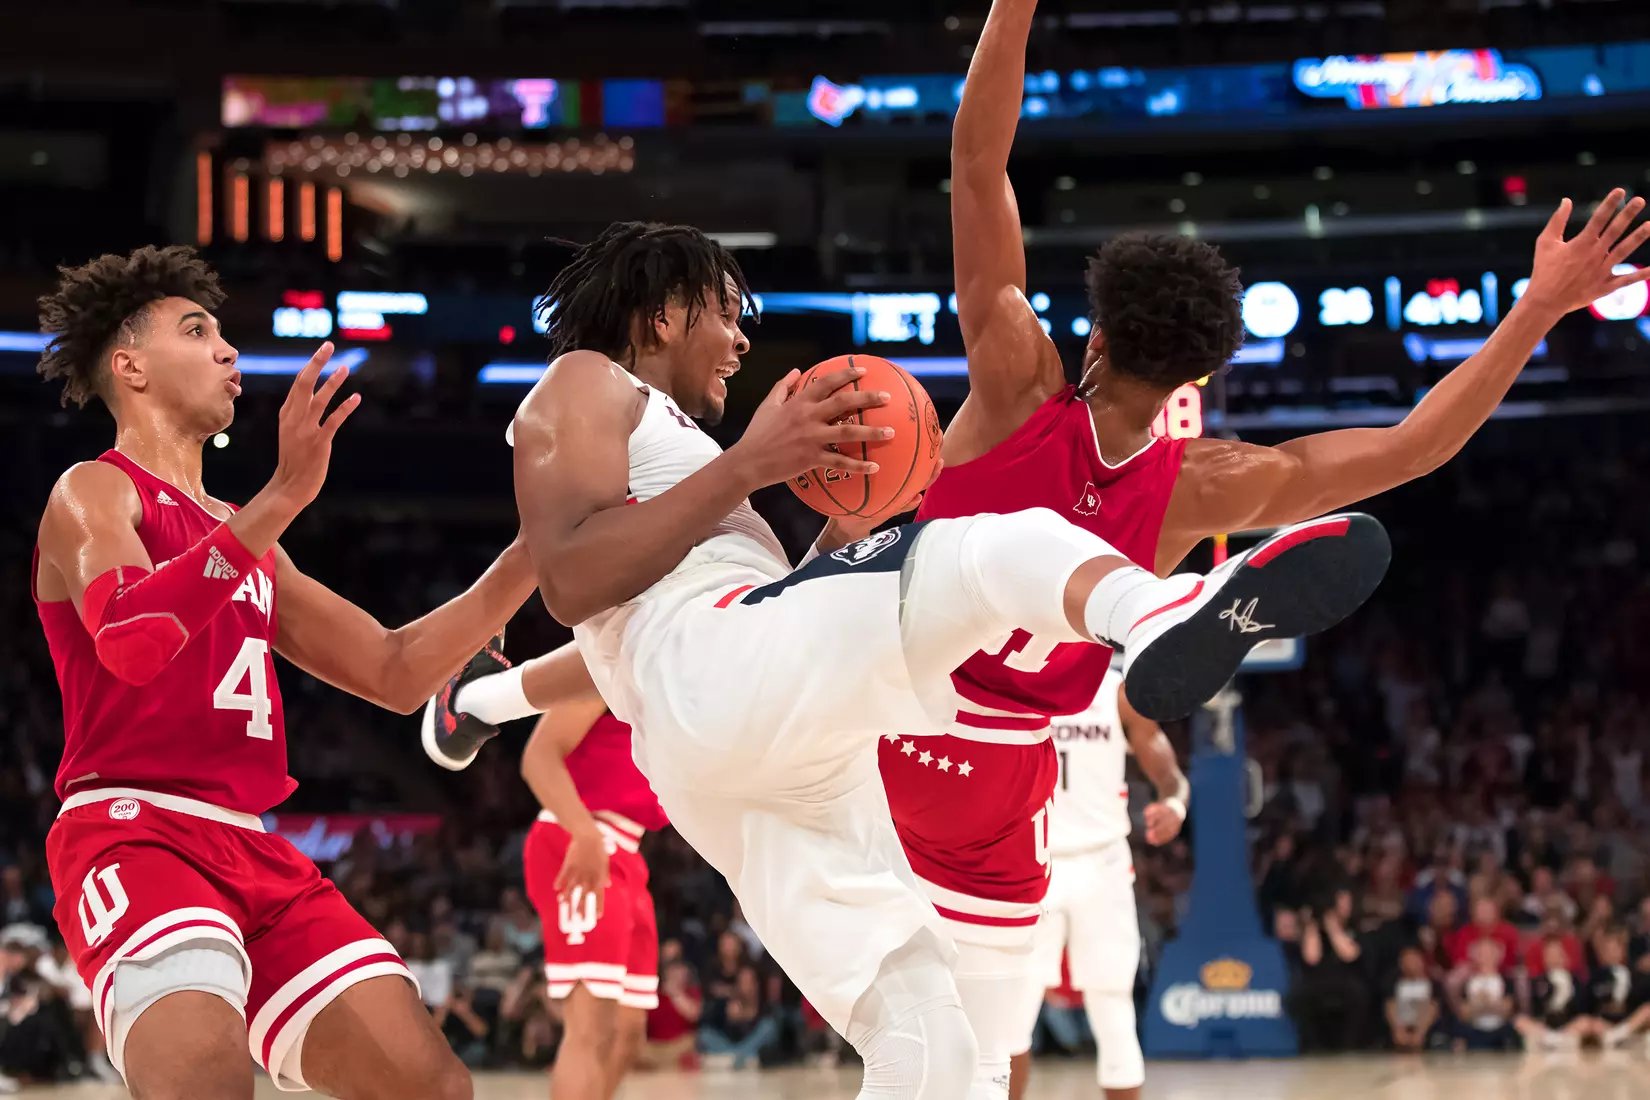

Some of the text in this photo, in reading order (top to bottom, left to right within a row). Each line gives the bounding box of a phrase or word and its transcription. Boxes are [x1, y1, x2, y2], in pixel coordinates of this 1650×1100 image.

[213, 637, 273, 740] 4
[1058, 751, 1068, 791] 1
[113, 802, 135, 813] 200
[78, 862, 130, 947] IU
